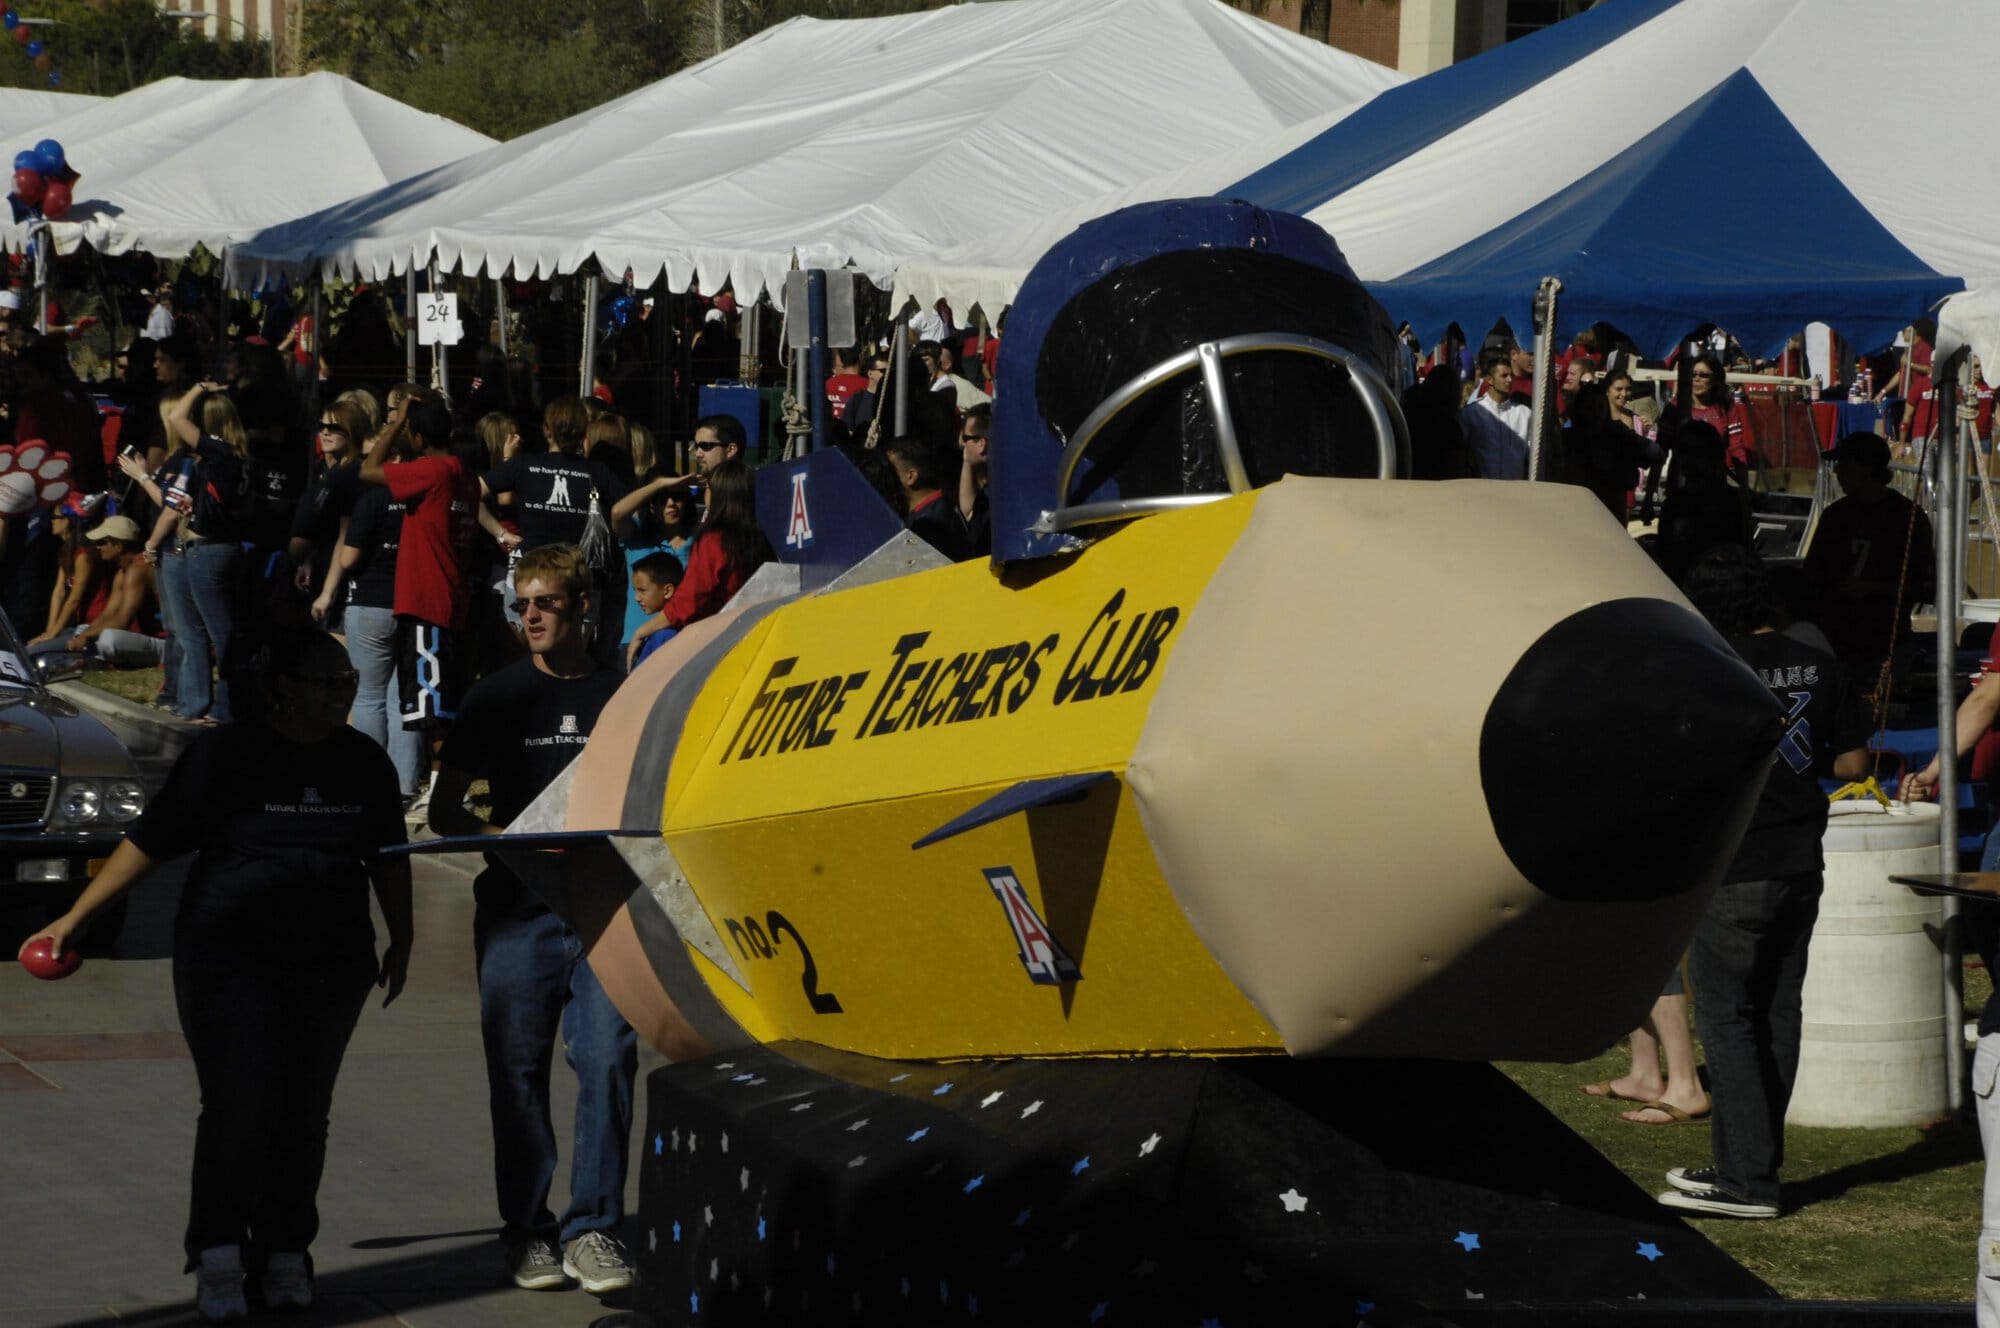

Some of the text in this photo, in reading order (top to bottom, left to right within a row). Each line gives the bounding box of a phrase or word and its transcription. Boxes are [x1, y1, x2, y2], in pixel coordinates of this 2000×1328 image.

[427, 304, 449, 322] 24
[528, 466, 541, 474] We
[542, 466, 558, 474] have
[559, 468, 570, 476] the
[533, 502, 543, 510] do
[786, 471, 813, 550] A
[719, 587, 1180, 765] FUTURE TEACHERS CLUB
[525, 737, 554, 747] FUTURE
[982, 866, 1083, 986] A
[723, 910, 844, 1014] no. 2
